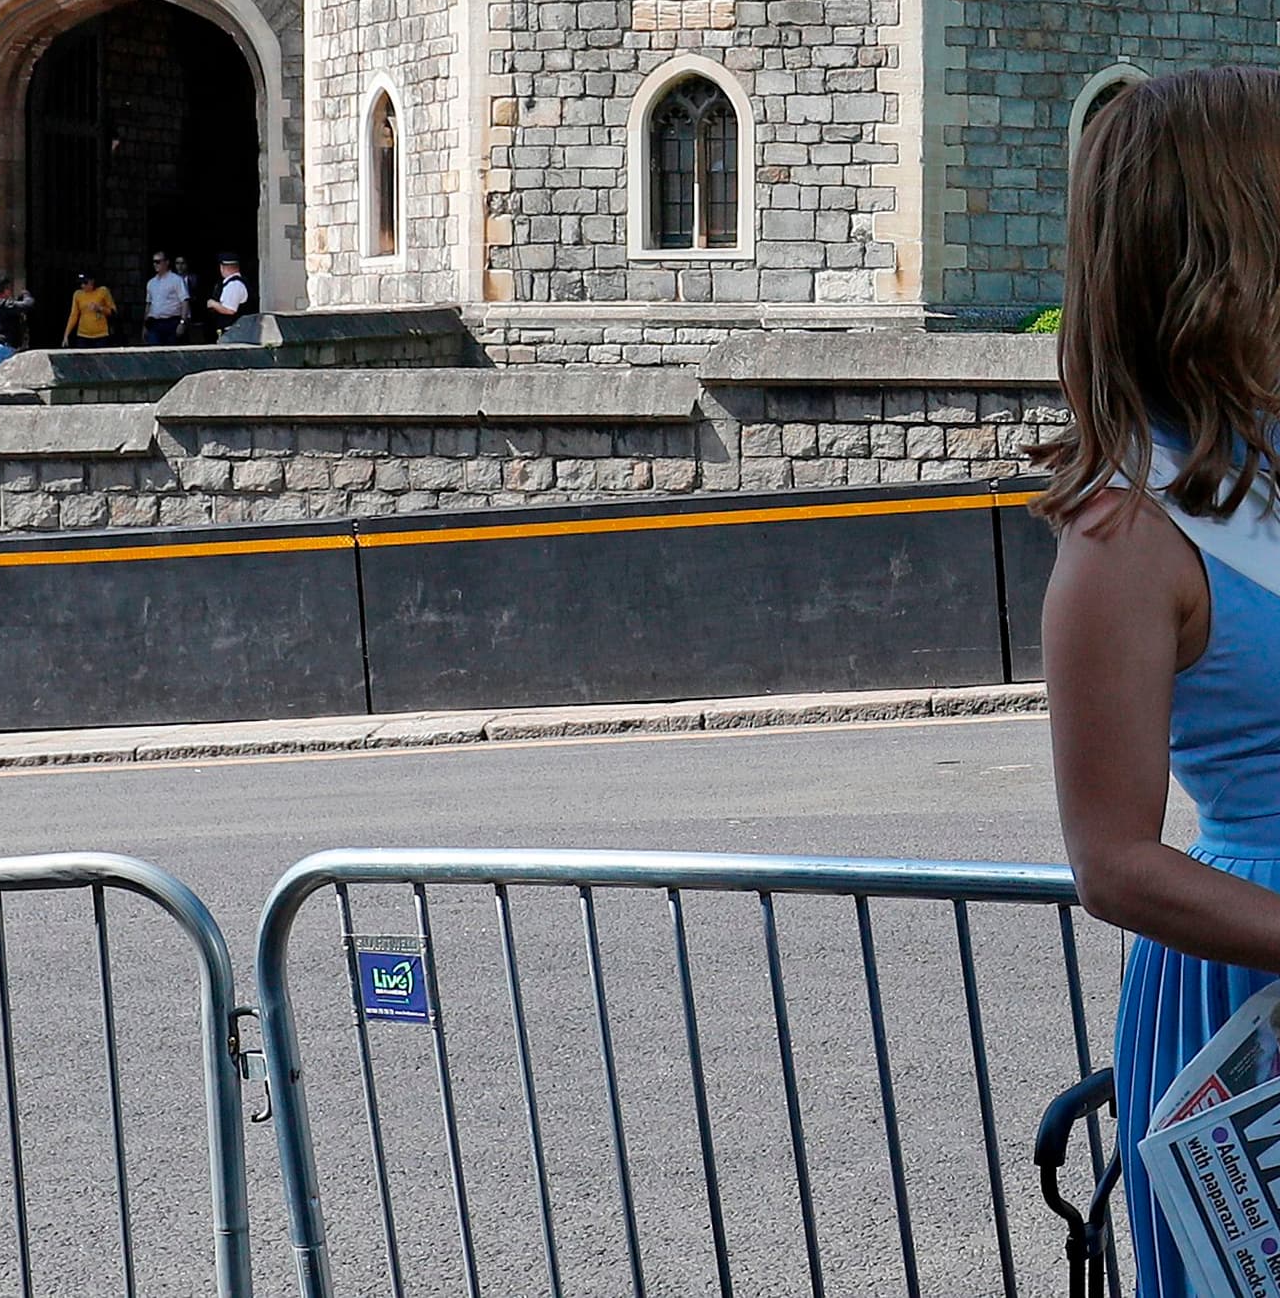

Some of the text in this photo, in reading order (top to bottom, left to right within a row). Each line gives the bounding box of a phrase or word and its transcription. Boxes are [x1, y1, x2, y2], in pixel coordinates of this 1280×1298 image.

[373, 967, 408, 989] Live
[1185, 1135, 1213, 1169] with
[1214, 1140, 1269, 1230] Admits deal
[1198, 1172, 1243, 1241] paparazzi
[1235, 1247, 1265, 1289] attack
